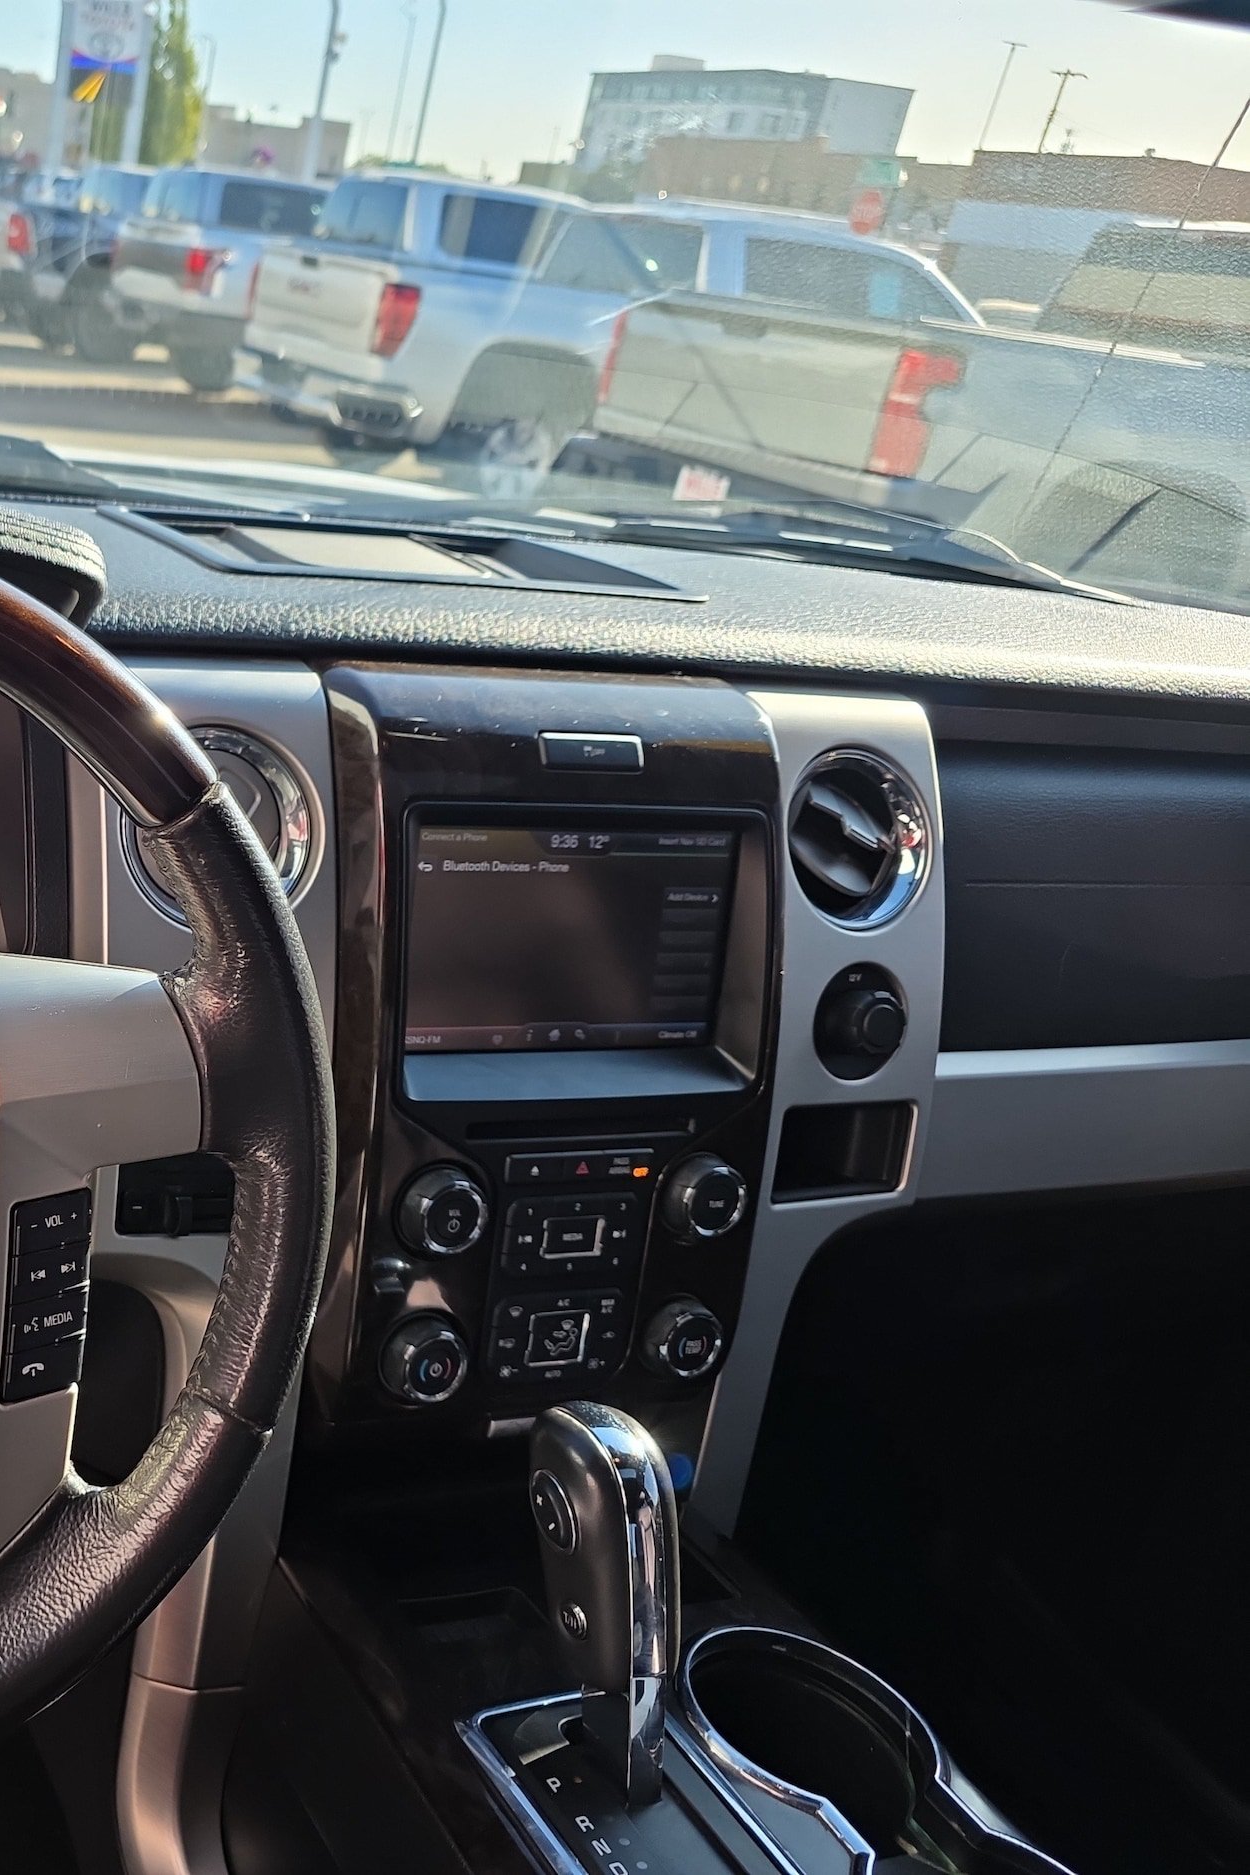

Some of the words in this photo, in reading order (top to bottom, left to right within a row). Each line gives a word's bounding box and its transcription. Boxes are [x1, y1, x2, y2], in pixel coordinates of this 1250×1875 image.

[422, 832, 454, 842] Connect
[463, 832, 488, 842] Phone
[442, 859, 490, 872] Bluetooth
[492, 859, 530, 872] Devices
[539, 860, 570, 873] Phone
[45, 1214, 64, 1228] VOL
[43, 1310, 73, 1328] MEDIA
[546, 1777, 561, 1793] P
[575, 1815, 595, 1832] R
[591, 1838, 612, 1856] N
